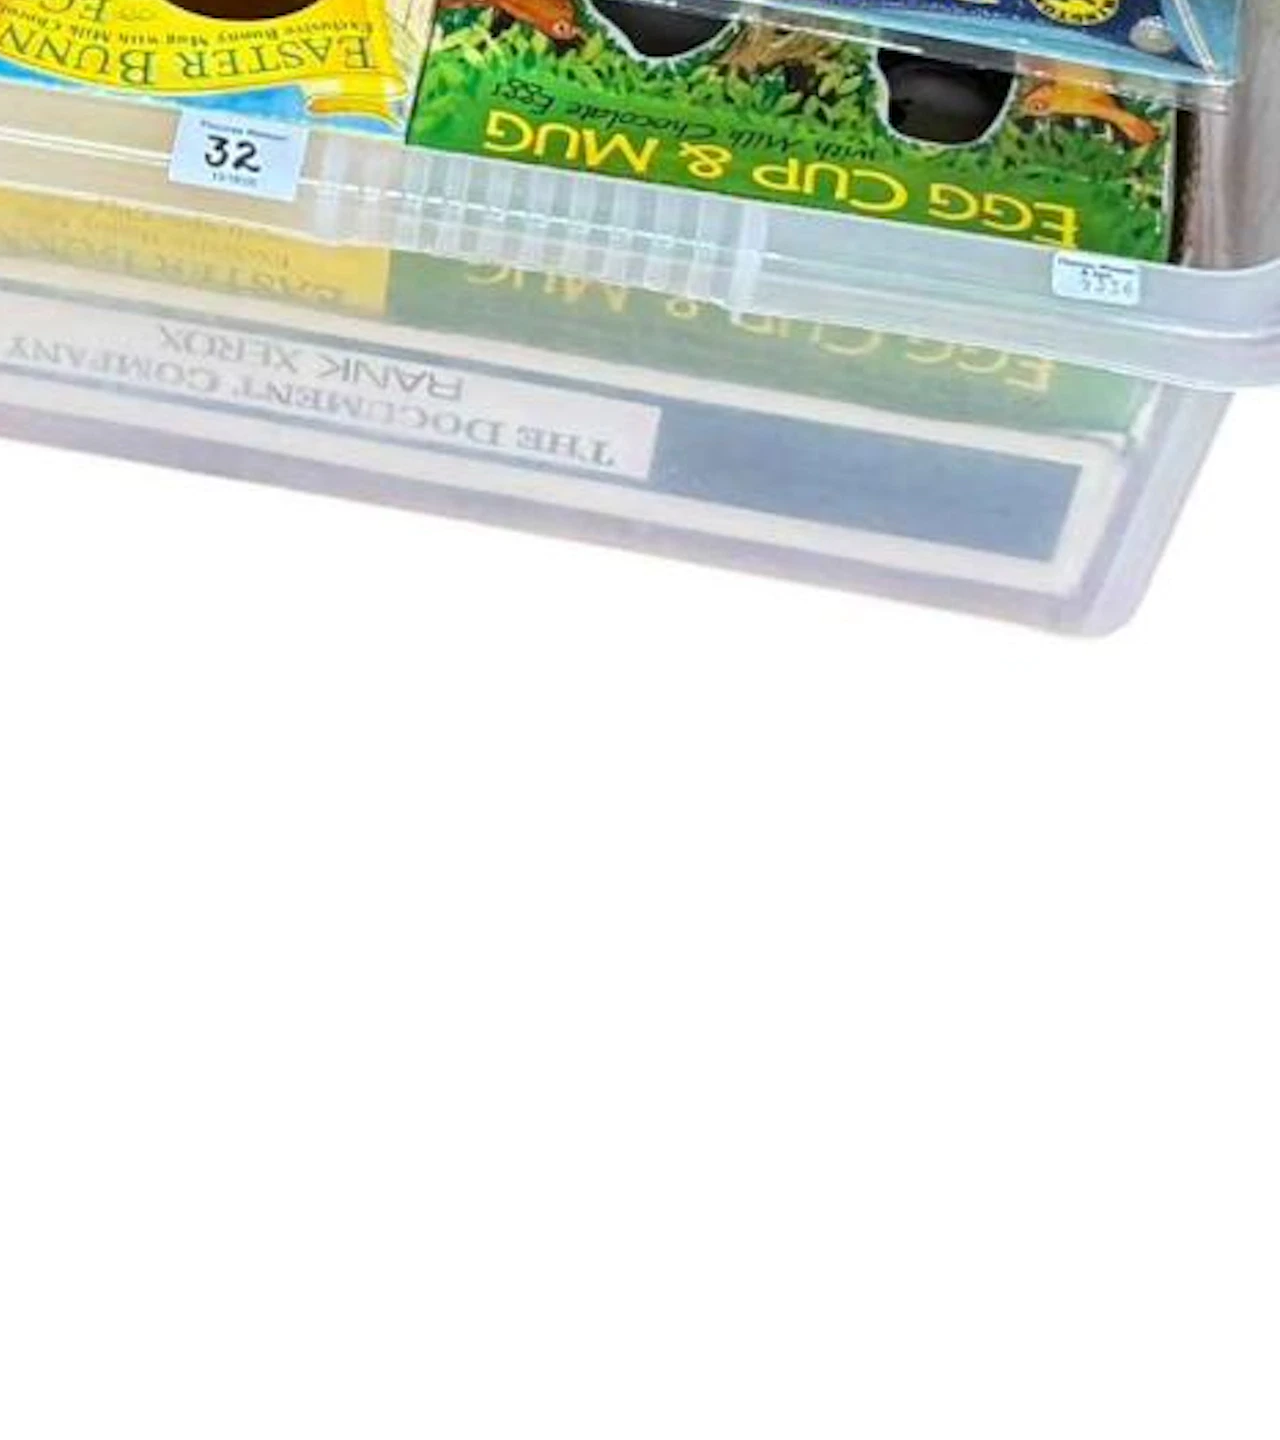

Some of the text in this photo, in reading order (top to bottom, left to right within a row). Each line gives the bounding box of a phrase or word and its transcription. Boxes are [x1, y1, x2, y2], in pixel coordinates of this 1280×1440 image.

[69, 23, 111, 43] Milk
[118, 29, 160, 46] with
[165, 31, 209, 47] Mug
[216, 25, 279, 43] Bunny
[177, 35, 378, 80] EASTER
[492, 77, 877, 162] with Milk Chocolate Eggs
[204, 133, 263, 173] 32
[482, 110, 1081, 250] EGG CUP & MUG
[158, 323, 467, 403] RANK XEROX
[6, 335, 616, 467] THE DOCUMENT COMPANY
